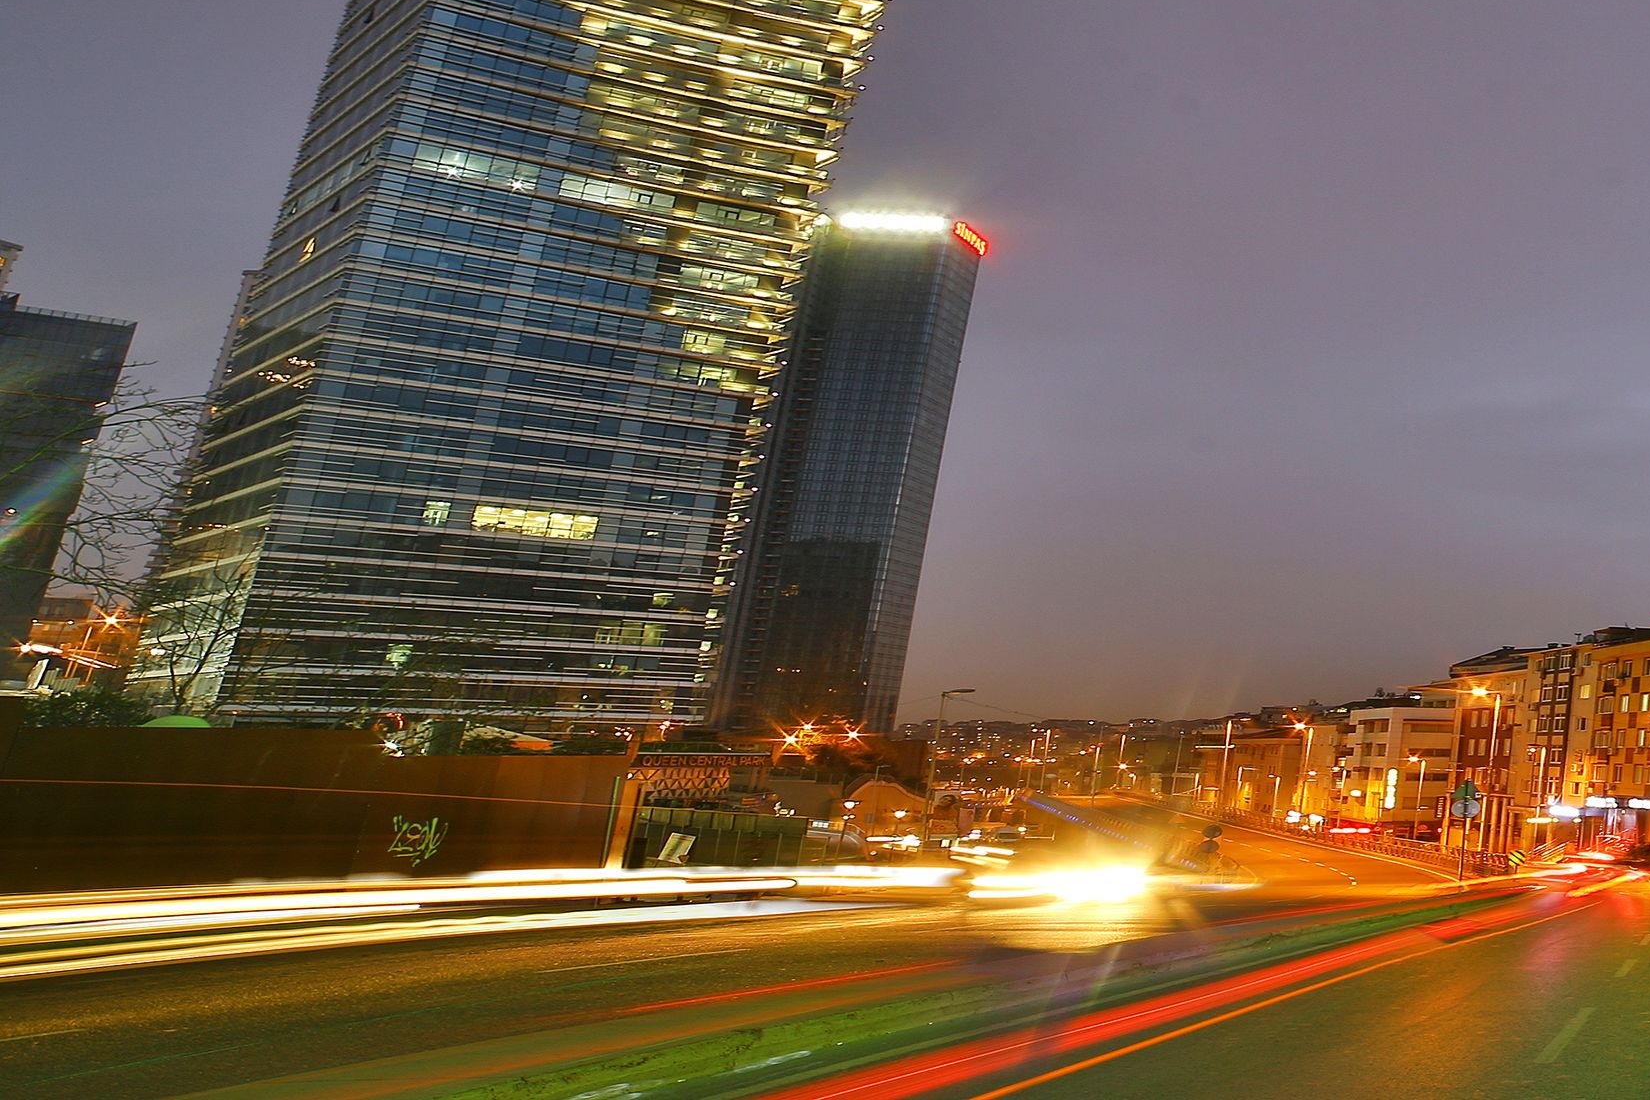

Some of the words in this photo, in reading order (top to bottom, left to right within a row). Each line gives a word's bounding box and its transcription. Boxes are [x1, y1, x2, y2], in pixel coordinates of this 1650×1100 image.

[642, 755, 687, 767] QUEEN
[689, 756, 737, 767] CENTRAL
[739, 756, 766, 767] PARK
